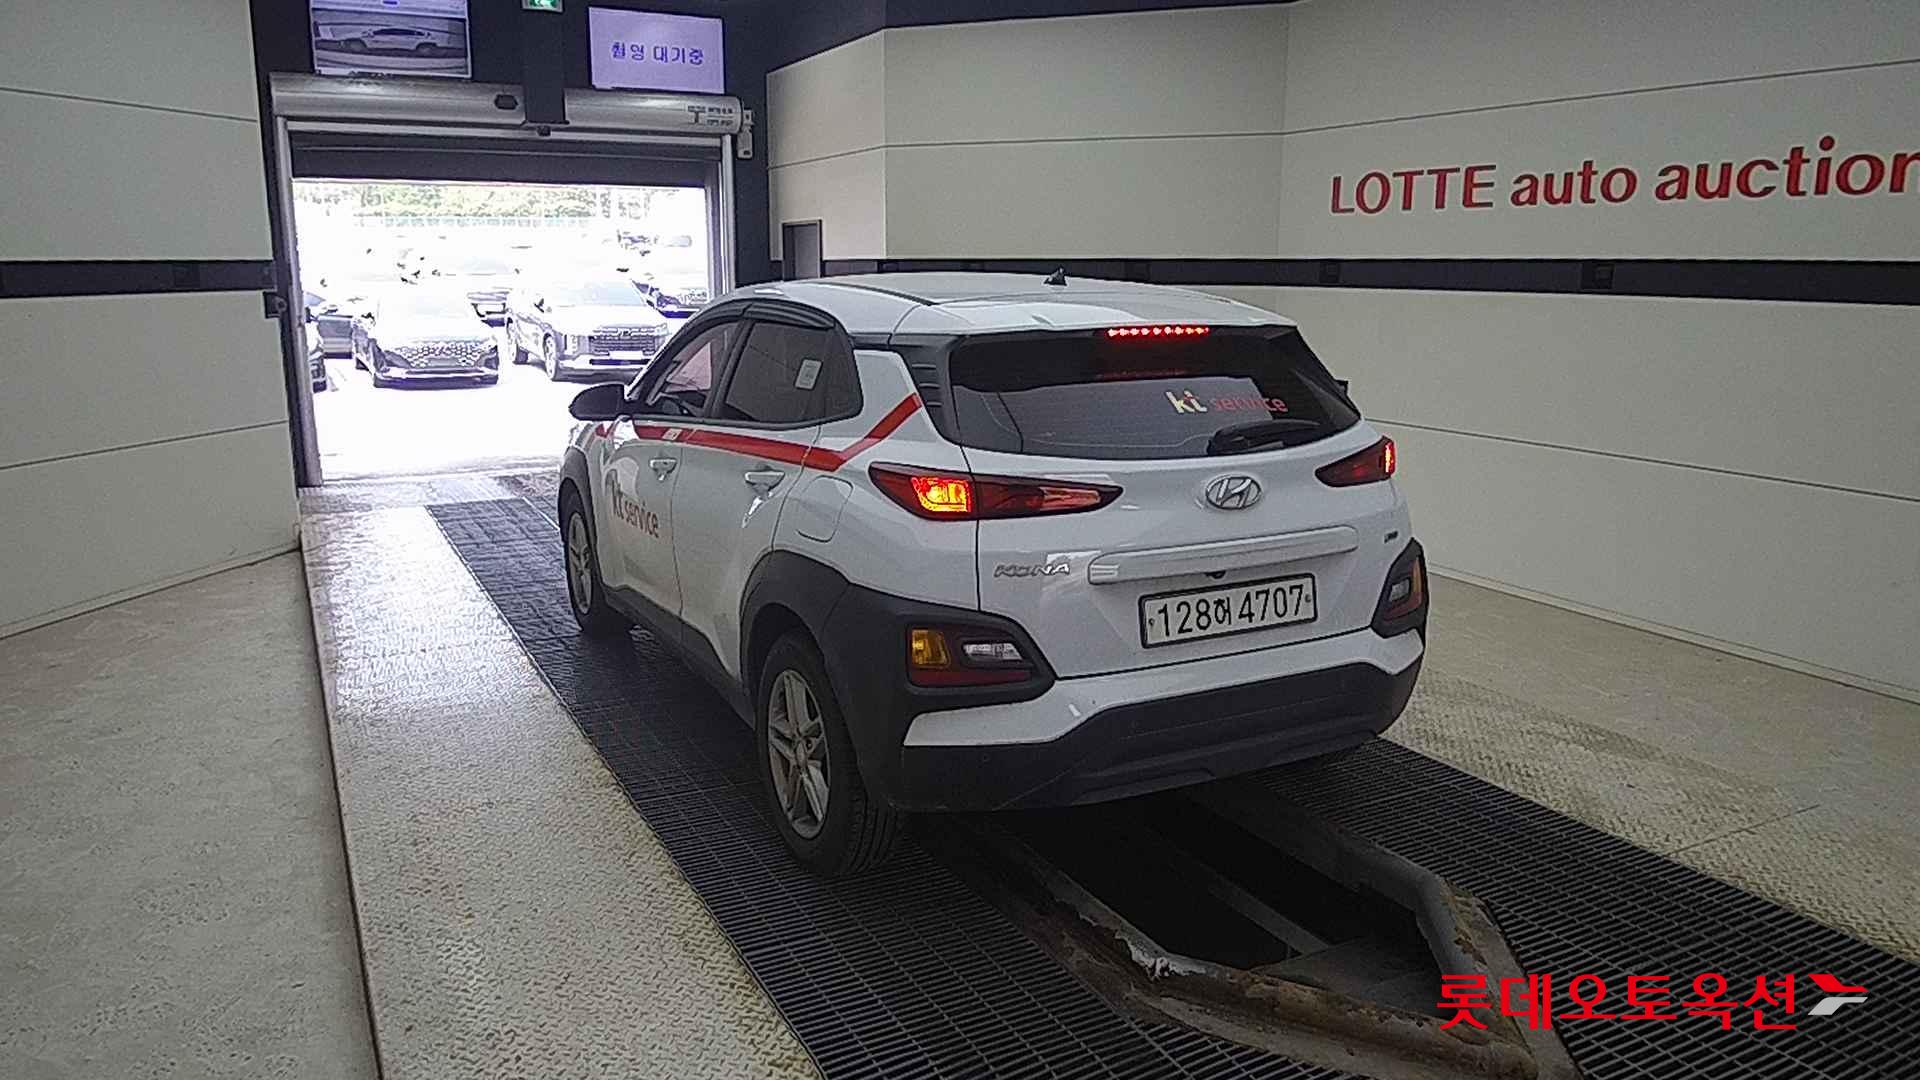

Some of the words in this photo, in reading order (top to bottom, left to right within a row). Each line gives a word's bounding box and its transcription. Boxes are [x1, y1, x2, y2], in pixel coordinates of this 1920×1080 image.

[1330, 164, 1496, 213] LOTTE
[1510, 160, 1637, 206] auto
[625, 500, 659, 538] service
[993, 562, 1071, 578] KONA
